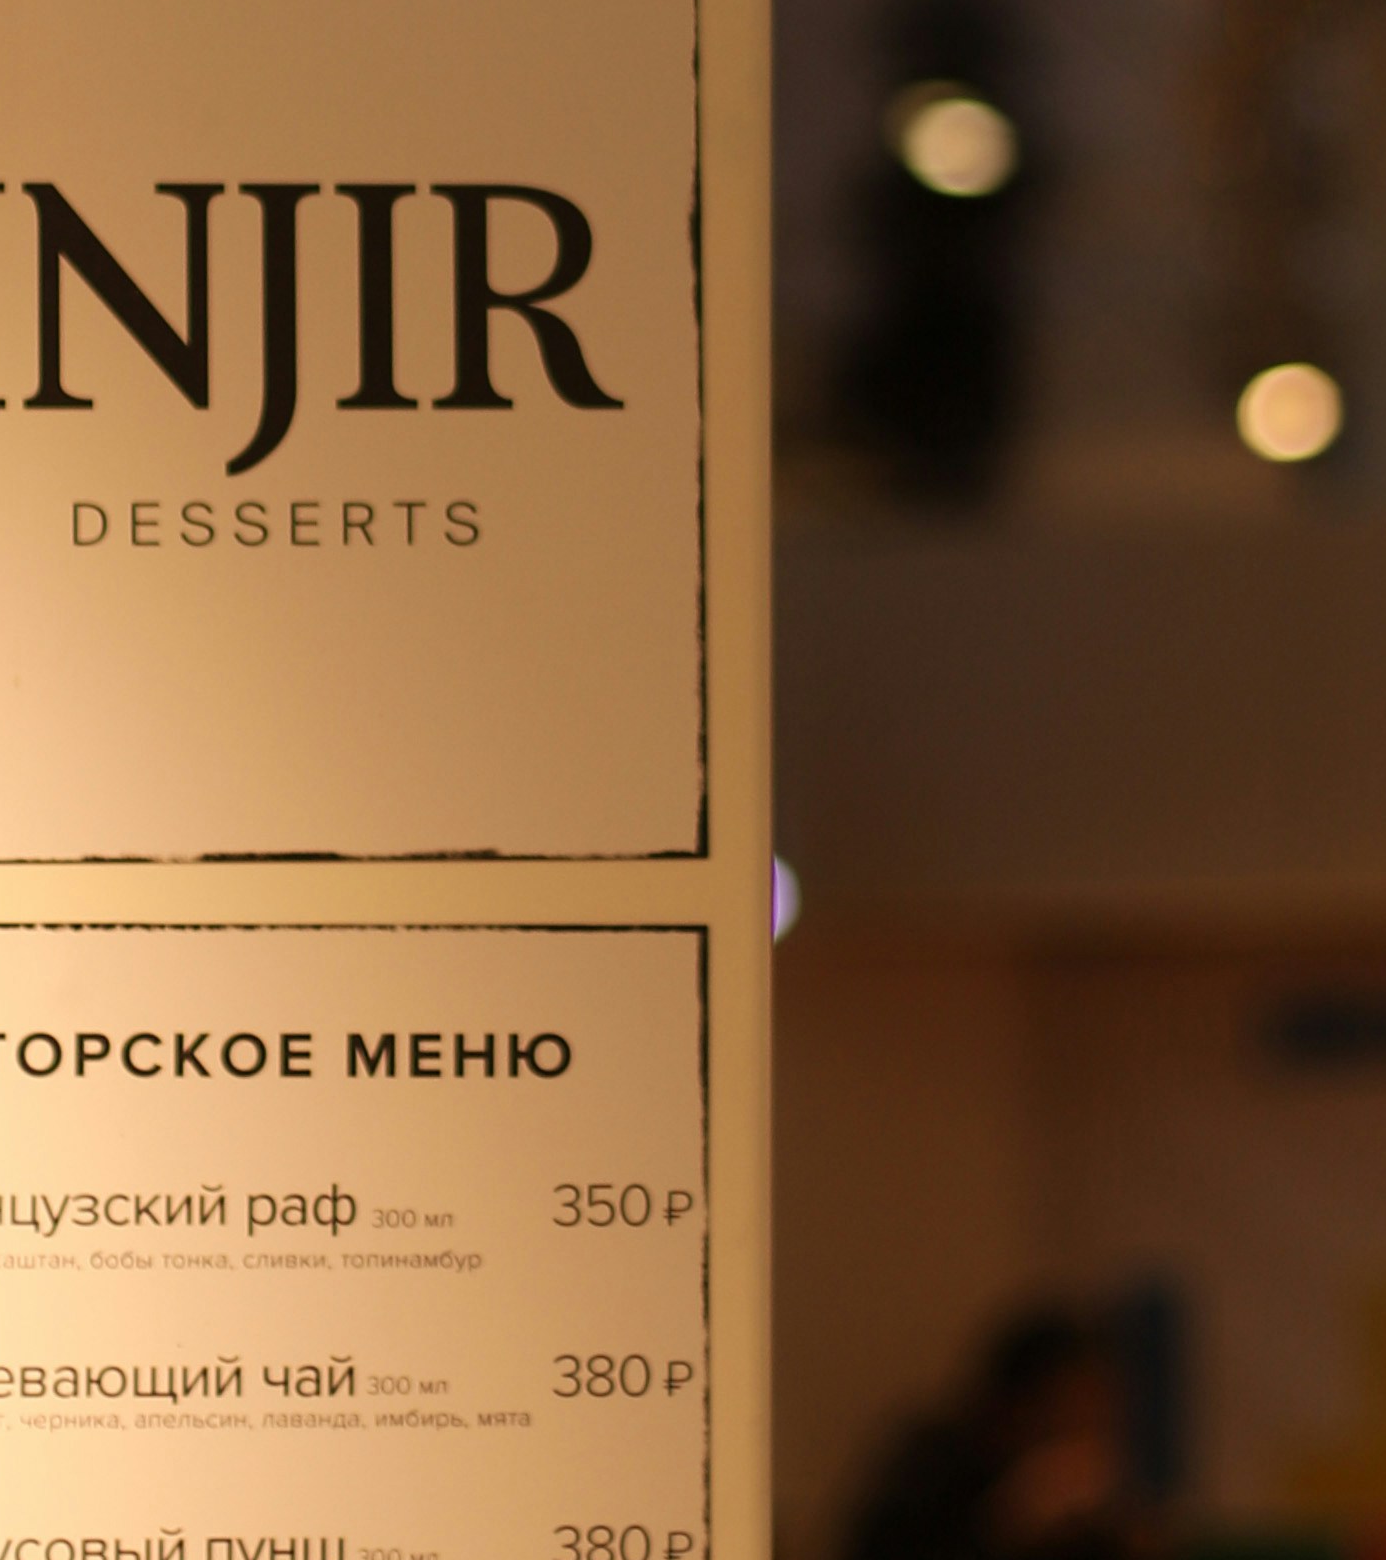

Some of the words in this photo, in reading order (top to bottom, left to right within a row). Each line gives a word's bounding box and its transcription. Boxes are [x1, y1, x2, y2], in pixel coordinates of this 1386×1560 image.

[72, 500, 481, 548] DESSERTS
[346, 1032, 572, 1079] МЕНЮ
[247, 1182, 357, 1238] раф
[371, 1207, 419, 1230] 300
[423, 1212, 454, 1228] мл
[89, 1249, 154, 1270] бобы
[242, 1253, 333, 1271] сливки,
[340, 1249, 483, 1274] топинамбур
[262, 1355, 356, 1398] чай
[366, 1373, 414, 1397] 300
[418, 1379, 449, 1395] мл
[134, 1412, 254, 1431] апельсин,
[261, 1411, 368, 1430] лаванда,
[374, 1407, 470, 1431] имбирь,
[476, 1411, 532, 1427] мята
